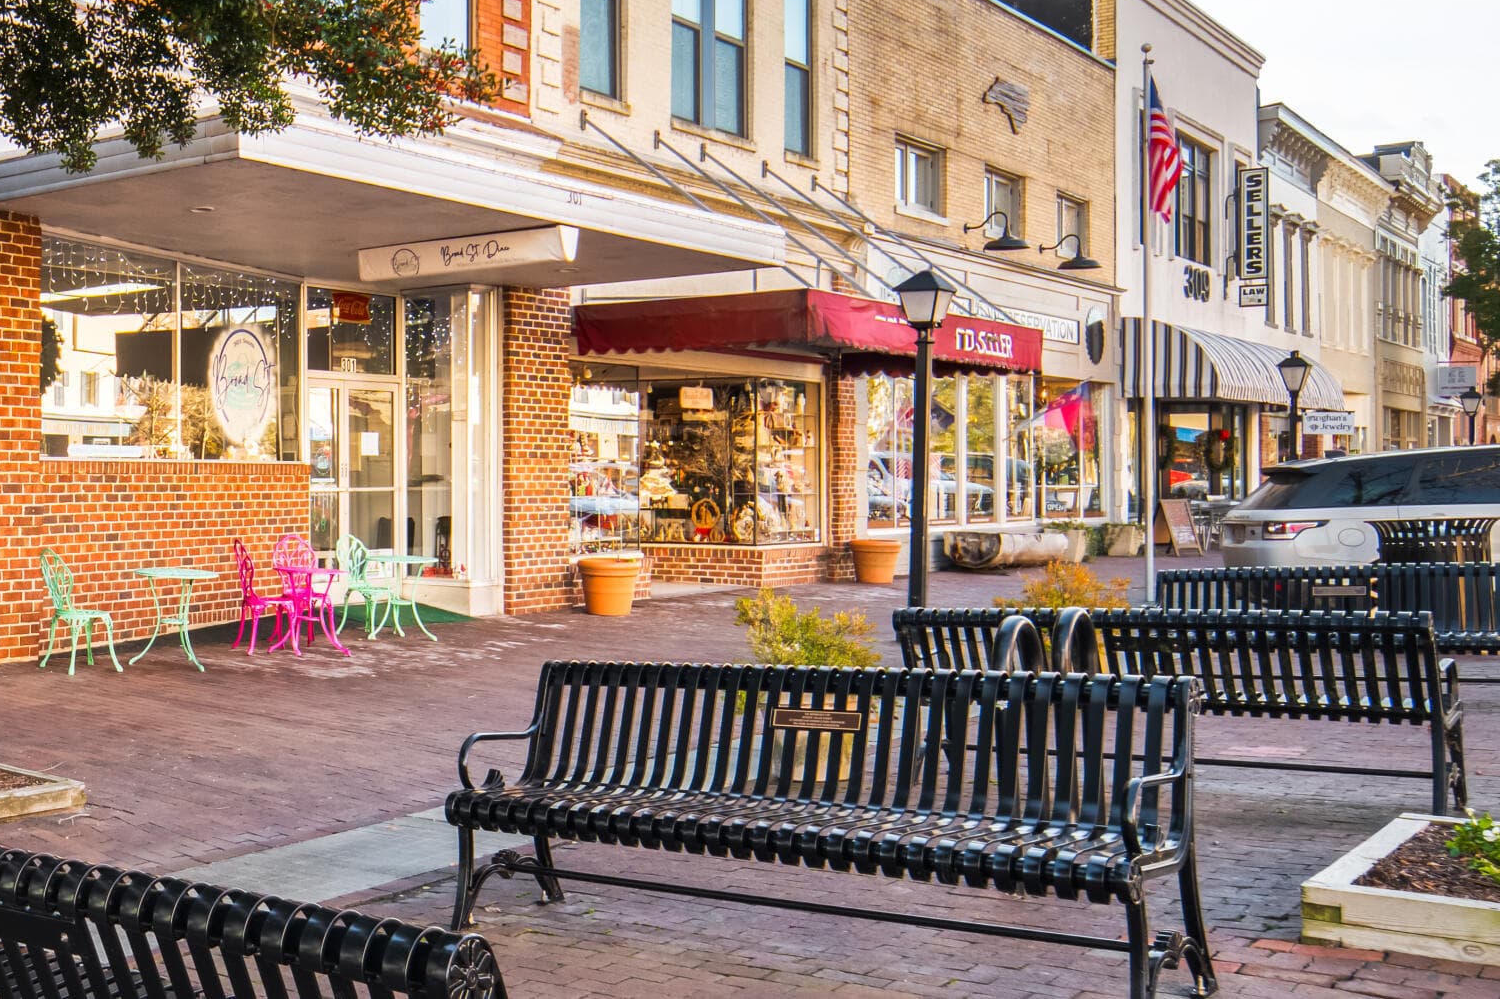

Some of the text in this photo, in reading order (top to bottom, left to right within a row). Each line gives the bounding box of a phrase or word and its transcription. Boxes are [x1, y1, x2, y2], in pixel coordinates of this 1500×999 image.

[1246, 174, 1262, 275] SELLERS
[1183, 265, 1210, 302] 309
[1243, 287, 1265, 296] LAW
[342, 358, 356, 373] 301
